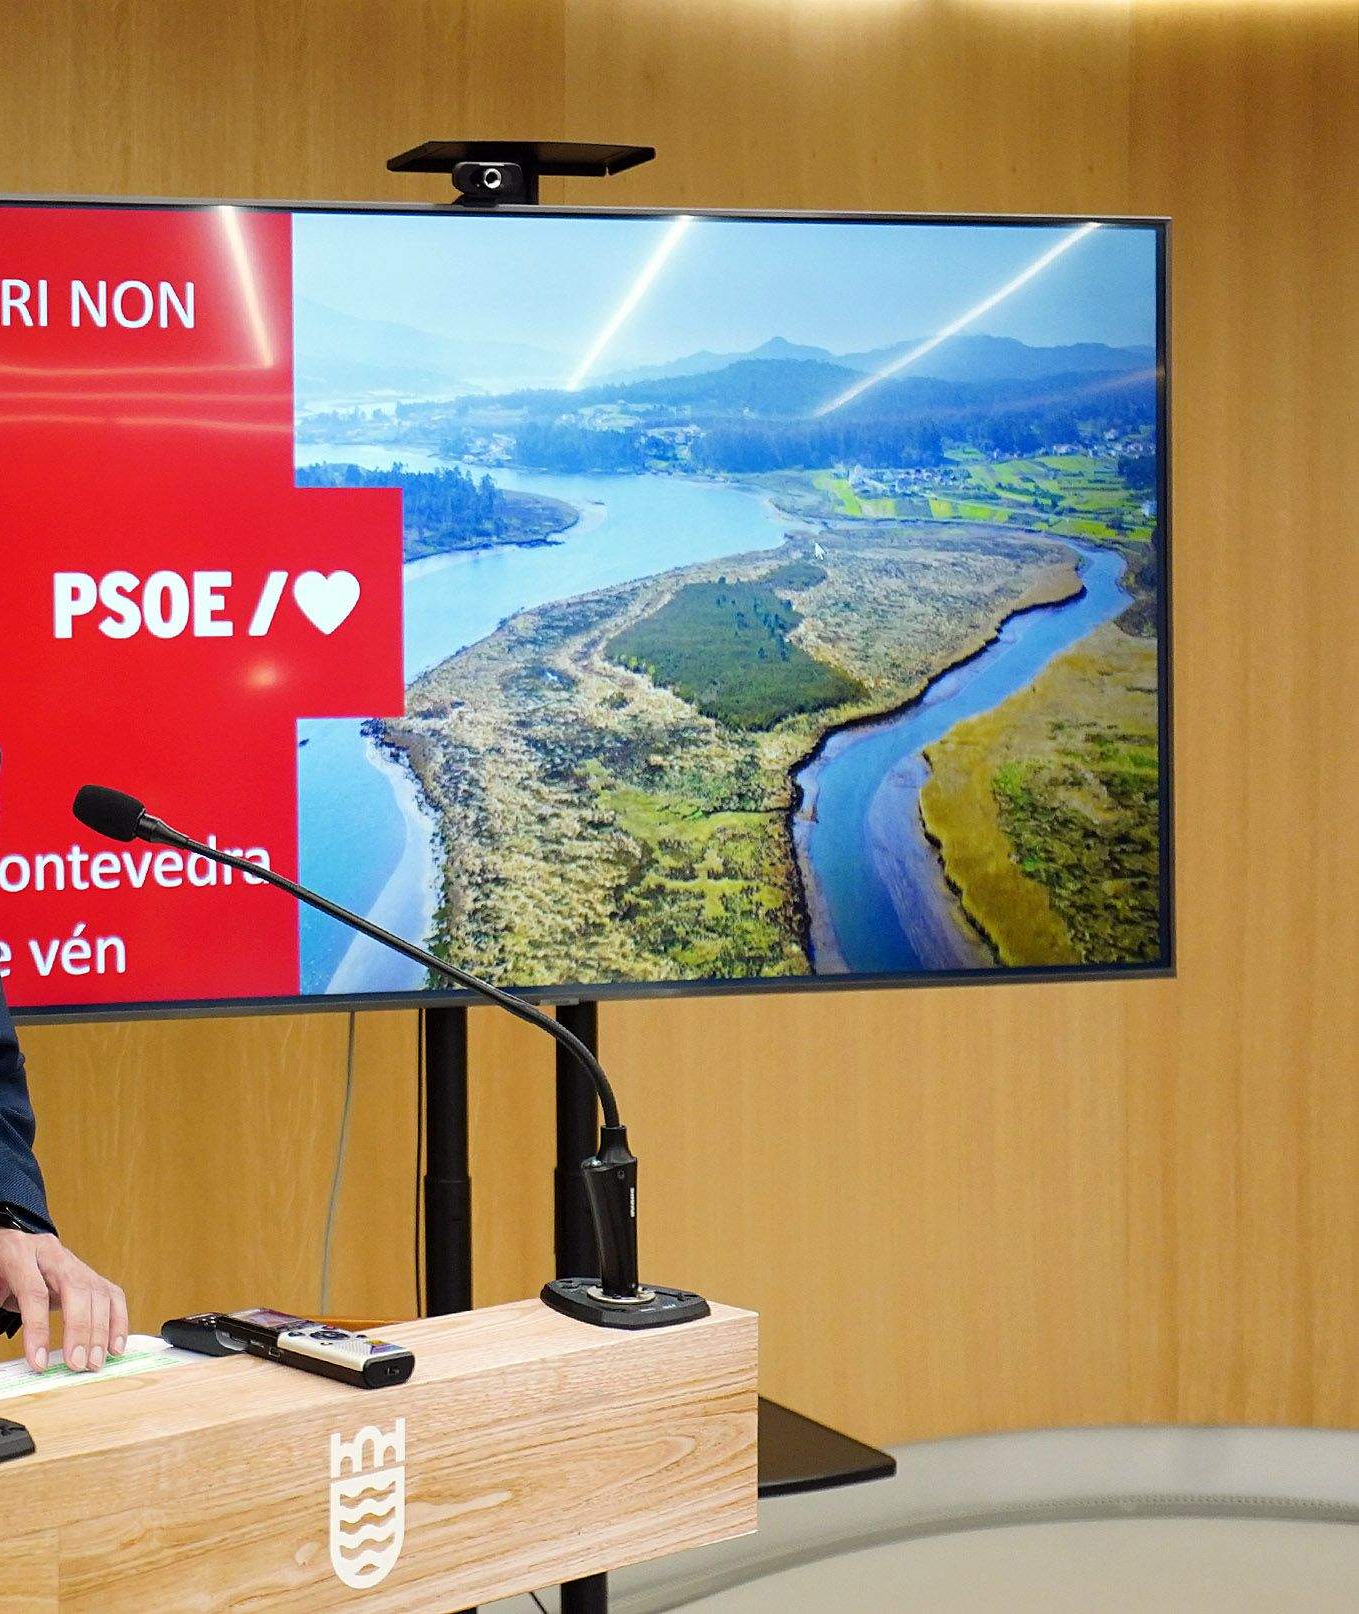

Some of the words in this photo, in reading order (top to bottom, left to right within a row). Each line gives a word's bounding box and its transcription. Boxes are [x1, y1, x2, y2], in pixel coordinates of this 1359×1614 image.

[71, 279, 195, 329] NON
[53, 570, 234, 639] PSOE
[28, 922, 126, 977] vén
